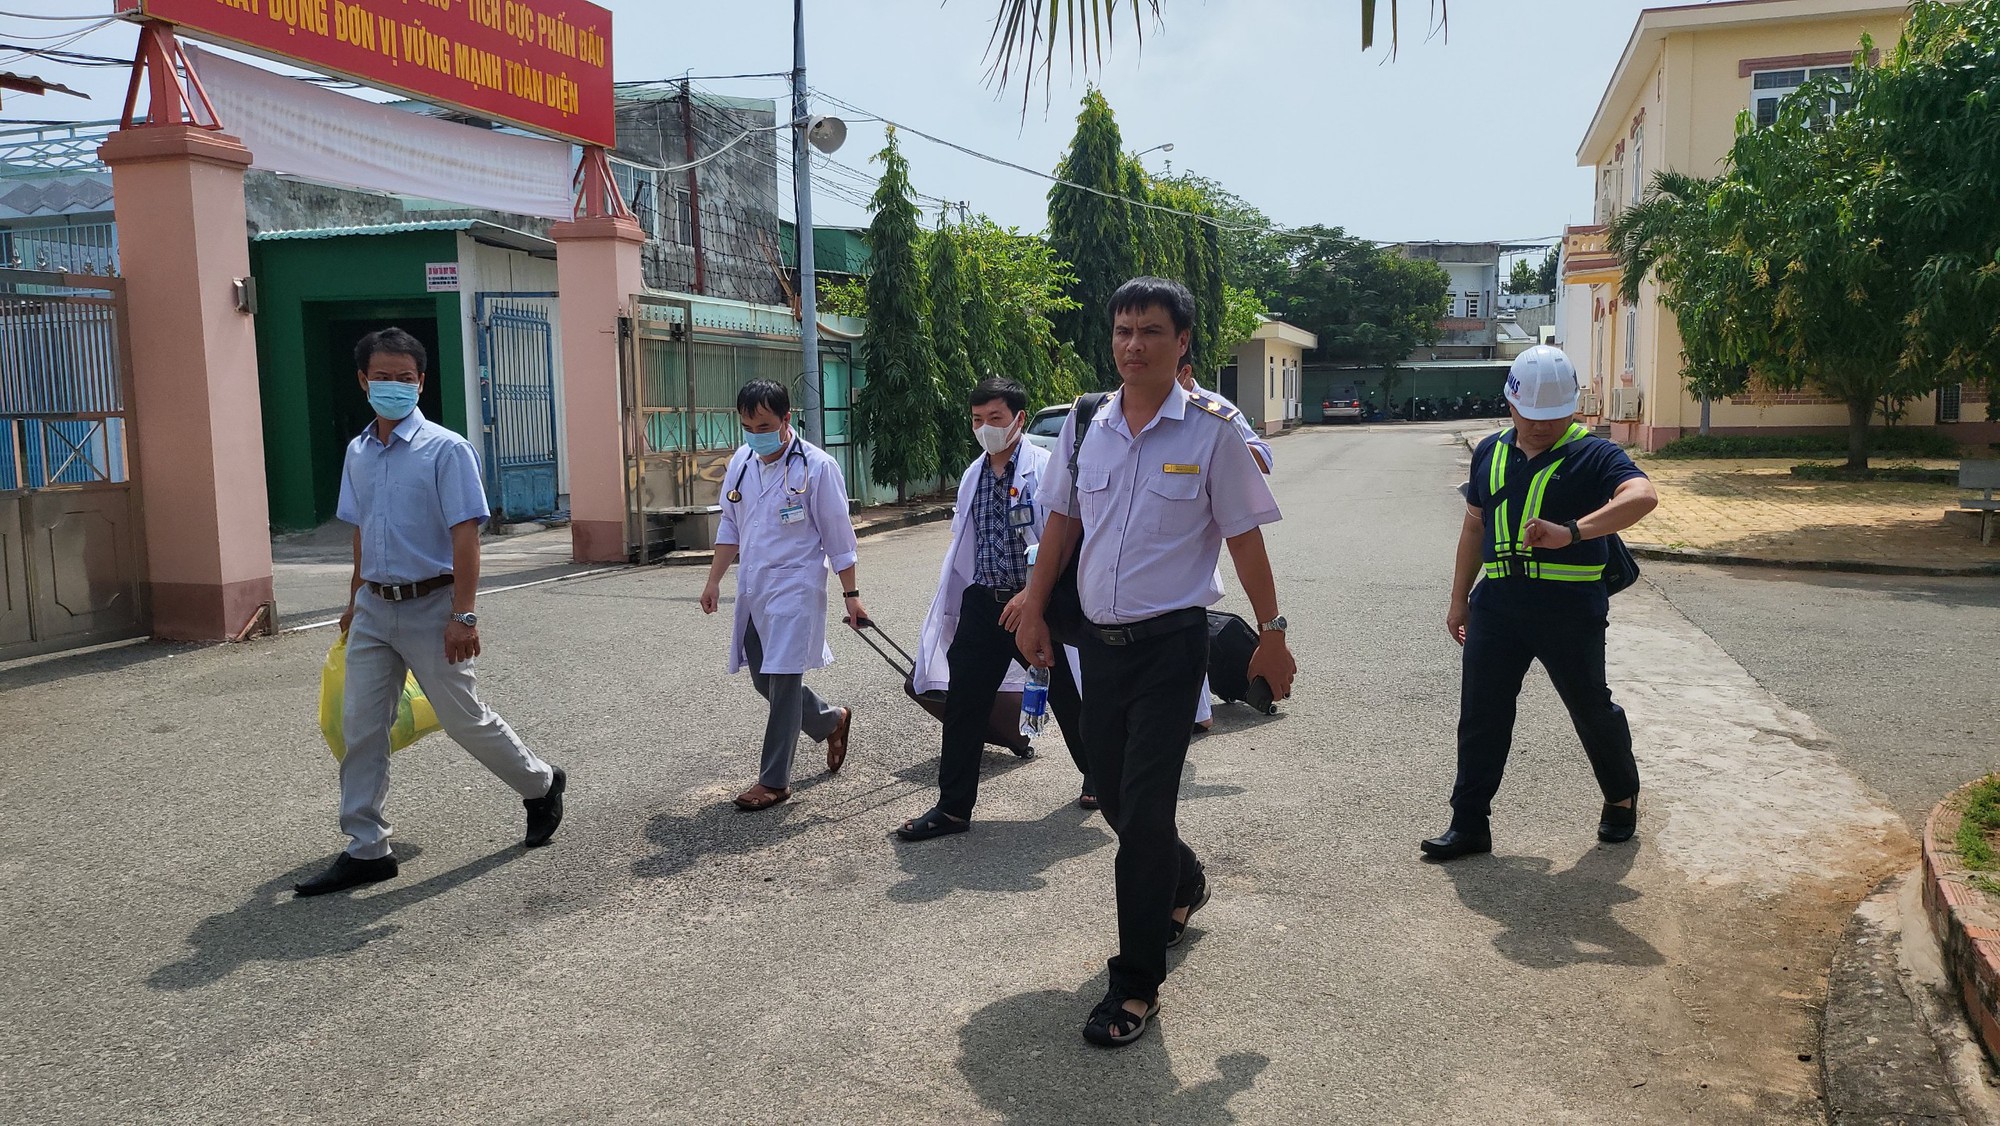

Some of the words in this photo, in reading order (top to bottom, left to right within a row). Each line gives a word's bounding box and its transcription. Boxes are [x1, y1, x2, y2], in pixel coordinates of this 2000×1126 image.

[334, 0, 376, 52] ĐƠN
[378, 15, 398, 67] VỊ
[400, 18, 451, 75] VỮNG
[454, 41, 503, 91] MẠNH
[504, 57, 544, 104] TOÀN
[545, 71, 579, 118] DIỆN
[505, 0, 535, 47] CỰC
[537, 11, 576, 59] PHẤN
[578, 24, 605, 69] ĐẤU
